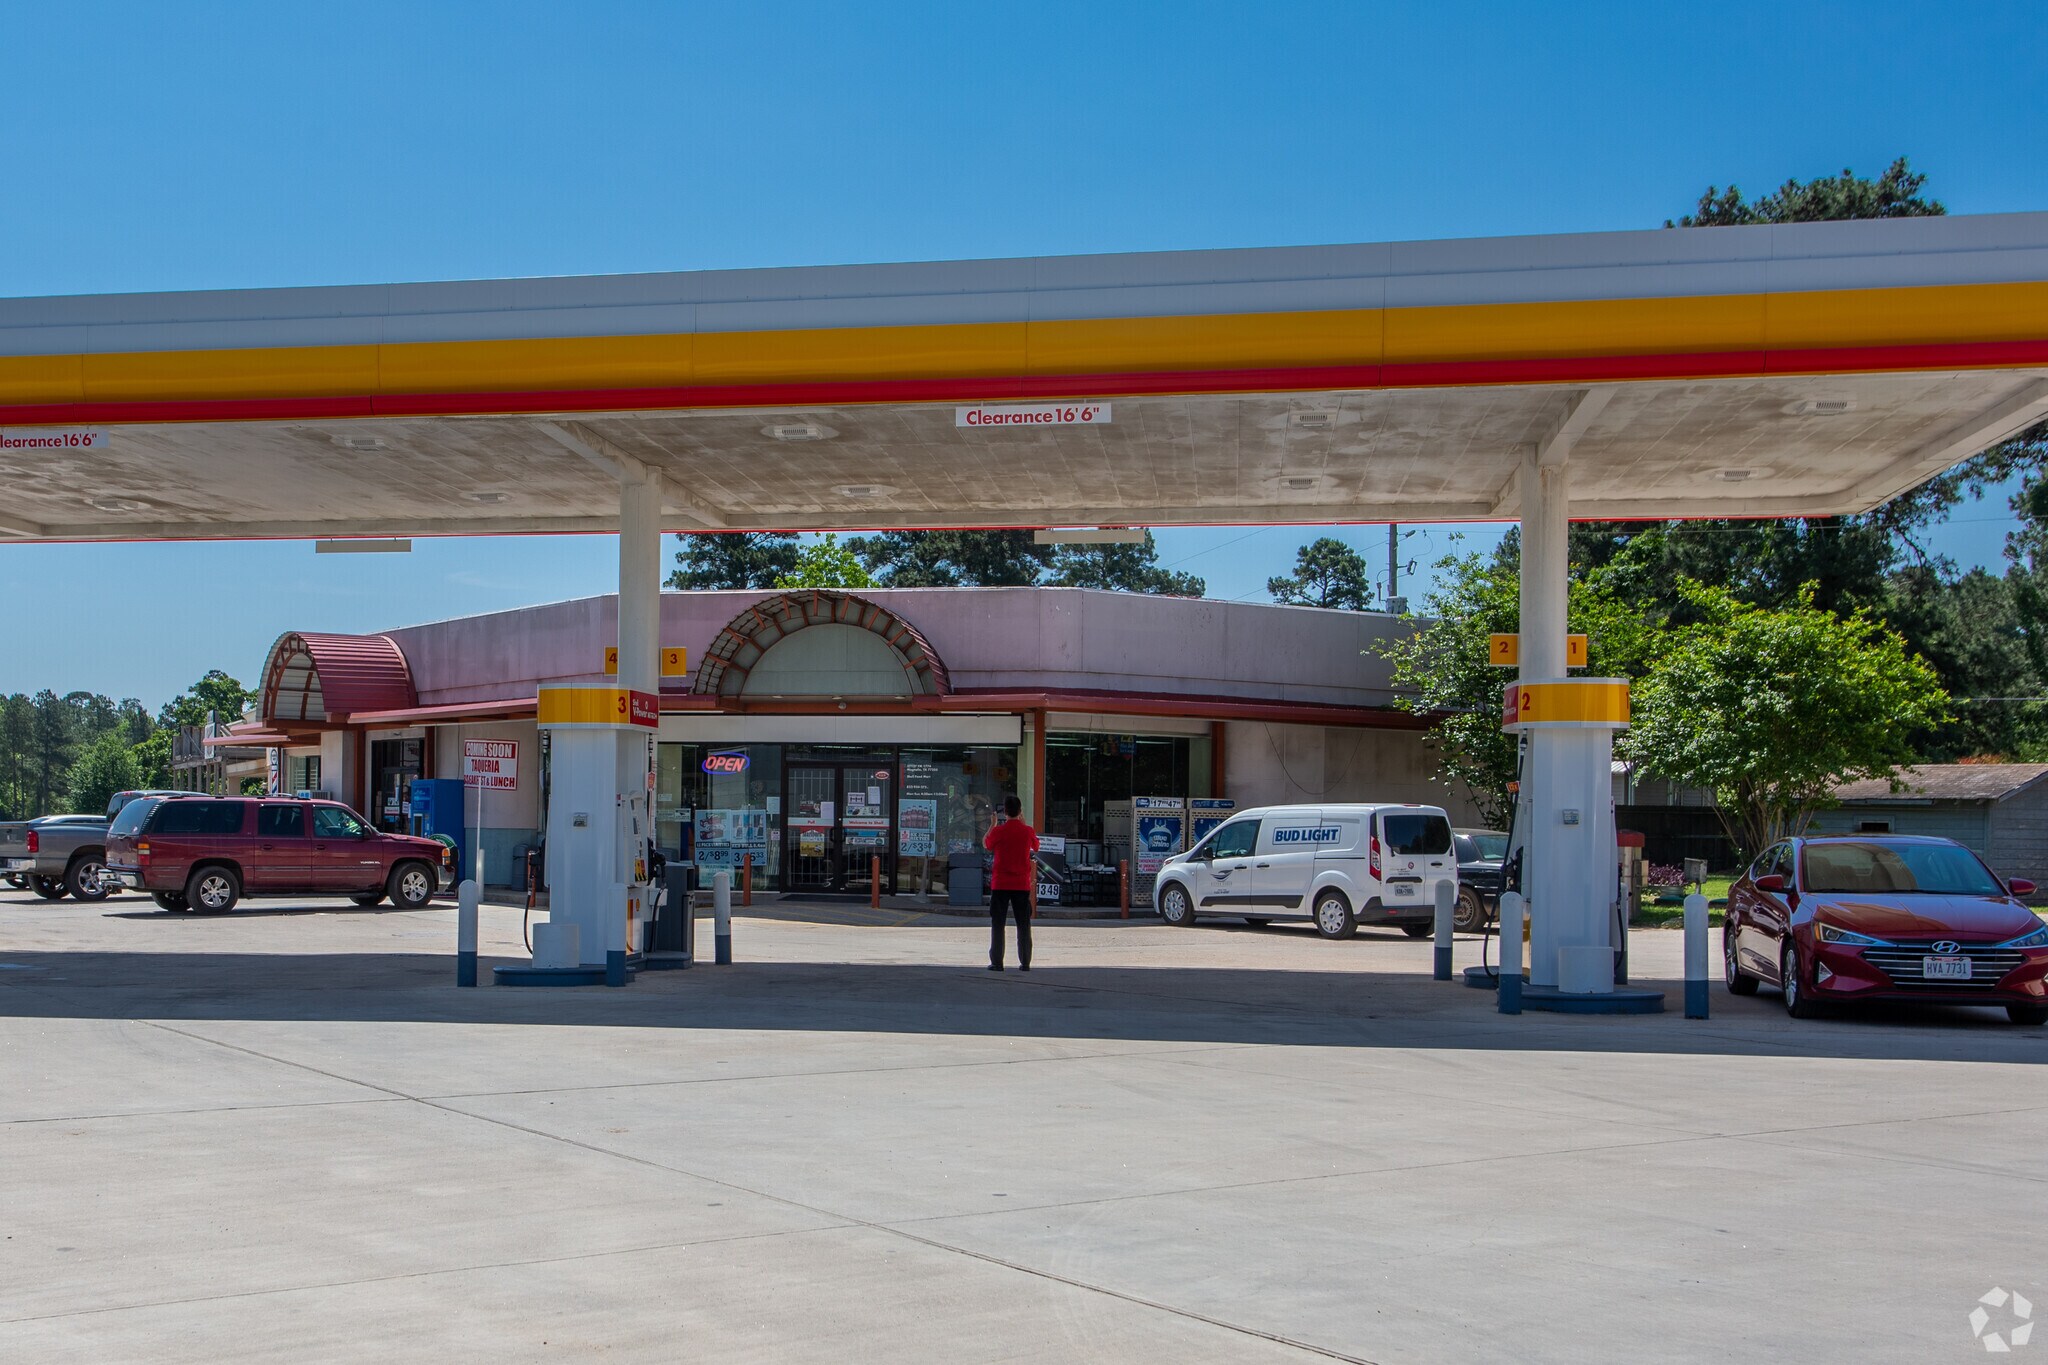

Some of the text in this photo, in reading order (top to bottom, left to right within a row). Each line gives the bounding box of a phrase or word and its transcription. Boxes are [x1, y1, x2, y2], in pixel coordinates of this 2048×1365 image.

[966, 410, 1053, 425] Clearance
[1499, 641, 1508, 653] 2
[1571, 642, 1577, 654] 1
[608, 652, 618, 664] 4
[670, 653, 678, 664] 3
[617, 696, 627, 714] 3
[1521, 692, 1531, 711] 2
[466, 742, 513, 758] COMING SOON
[471, 759, 500, 774] TAQUERIA
[705, 755, 746, 772] OPEN
[464, 774, 486, 786] BREAKFST
[490, 776, 515, 788] LUNCH
[1275, 829, 1338, 842] BUD LIGHT
[1946, 963, 1967, 974] 7731
